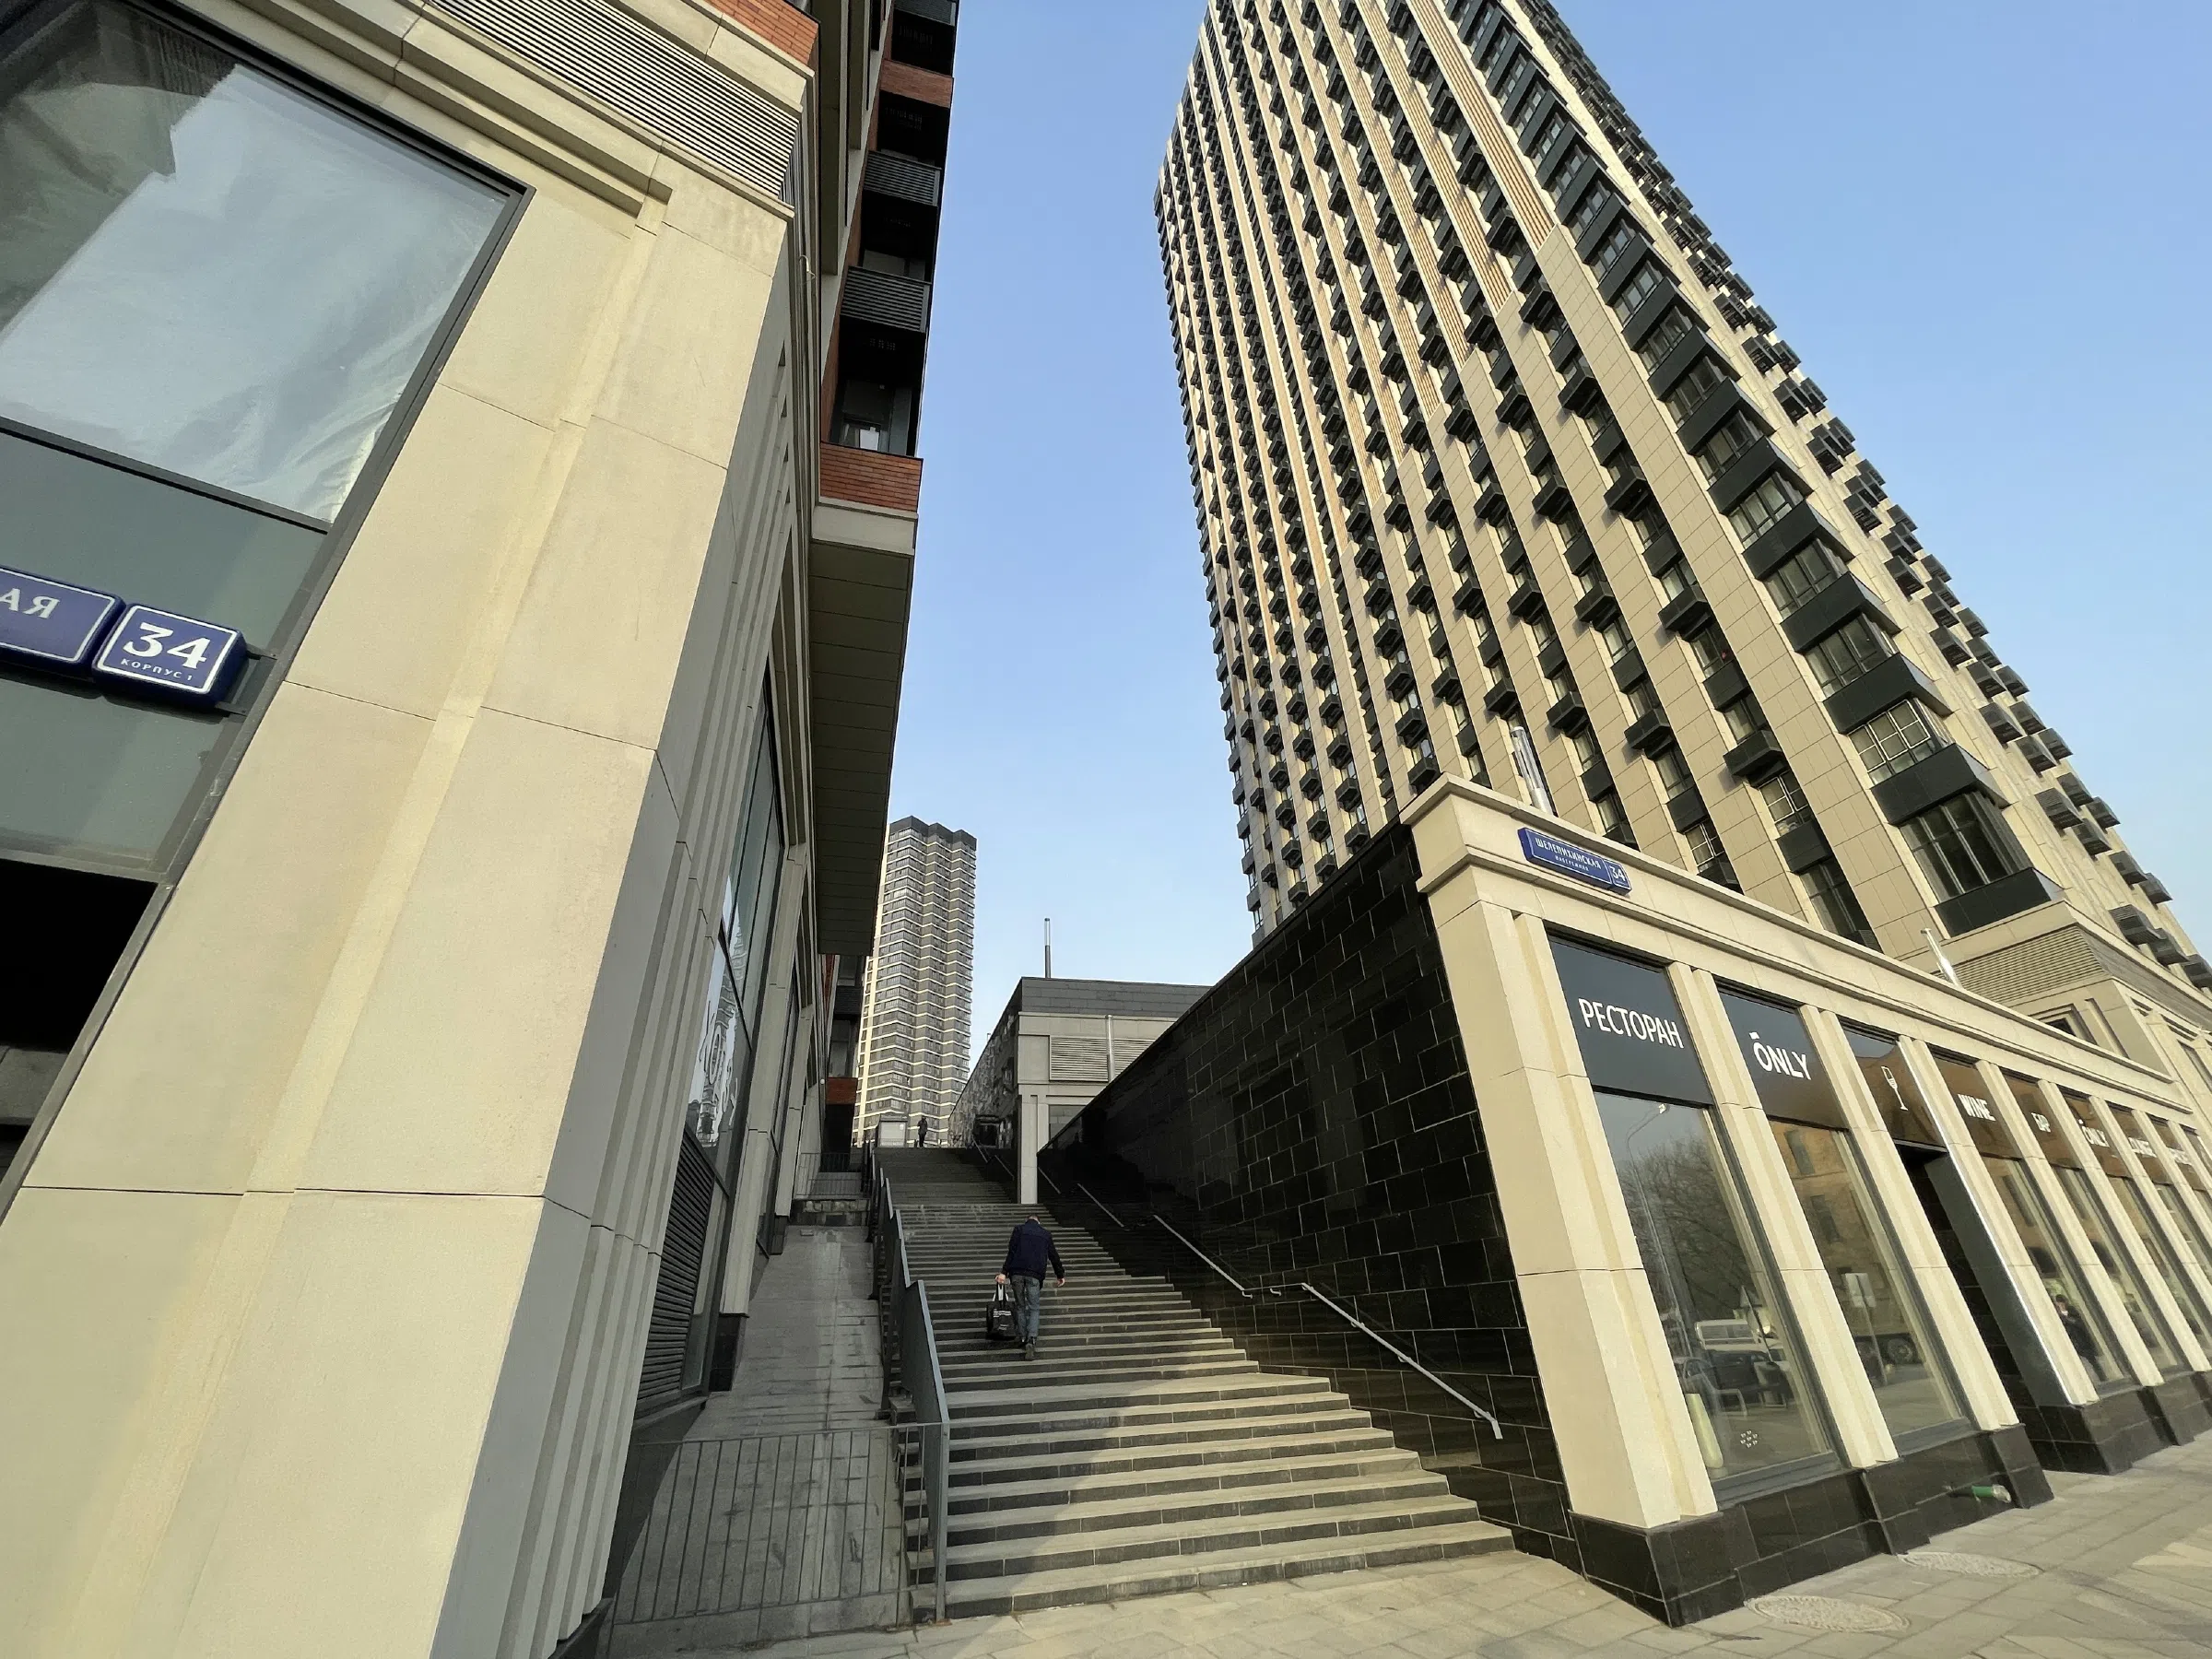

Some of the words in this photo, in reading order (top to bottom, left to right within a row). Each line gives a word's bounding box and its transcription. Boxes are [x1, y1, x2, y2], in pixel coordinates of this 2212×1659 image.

[123, 621, 212, 669] 34
[121, 658, 182, 678] КОРПУС
[1535, 837, 1602, 869] ШЕЛЕПИХИНСКАЯ
[1609, 865, 1626, 882] 34
[1578, 998, 1684, 1049] РЕСТОРАН
[1957, 1094, 1996, 1122] WINE
